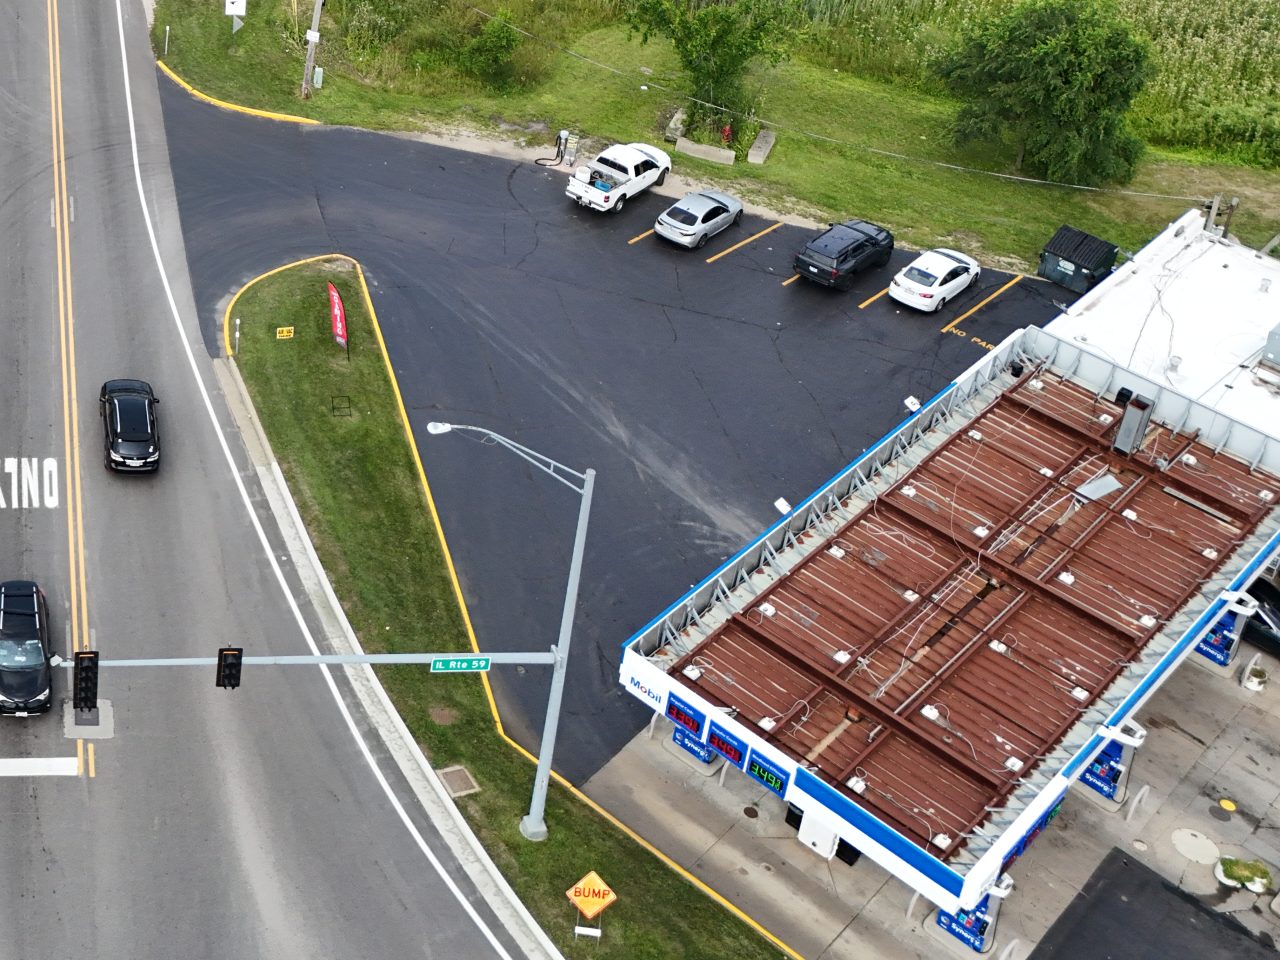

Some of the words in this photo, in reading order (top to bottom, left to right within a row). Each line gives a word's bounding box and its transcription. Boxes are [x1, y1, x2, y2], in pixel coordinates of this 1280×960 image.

[949, 326, 967, 337] NO
[435, 661, 445, 669] IL
[449, 660, 468, 669] Rte
[471, 660, 486, 669] 59
[630, 676, 662, 704] Mobil
[574, 887, 610, 900] BUMP
